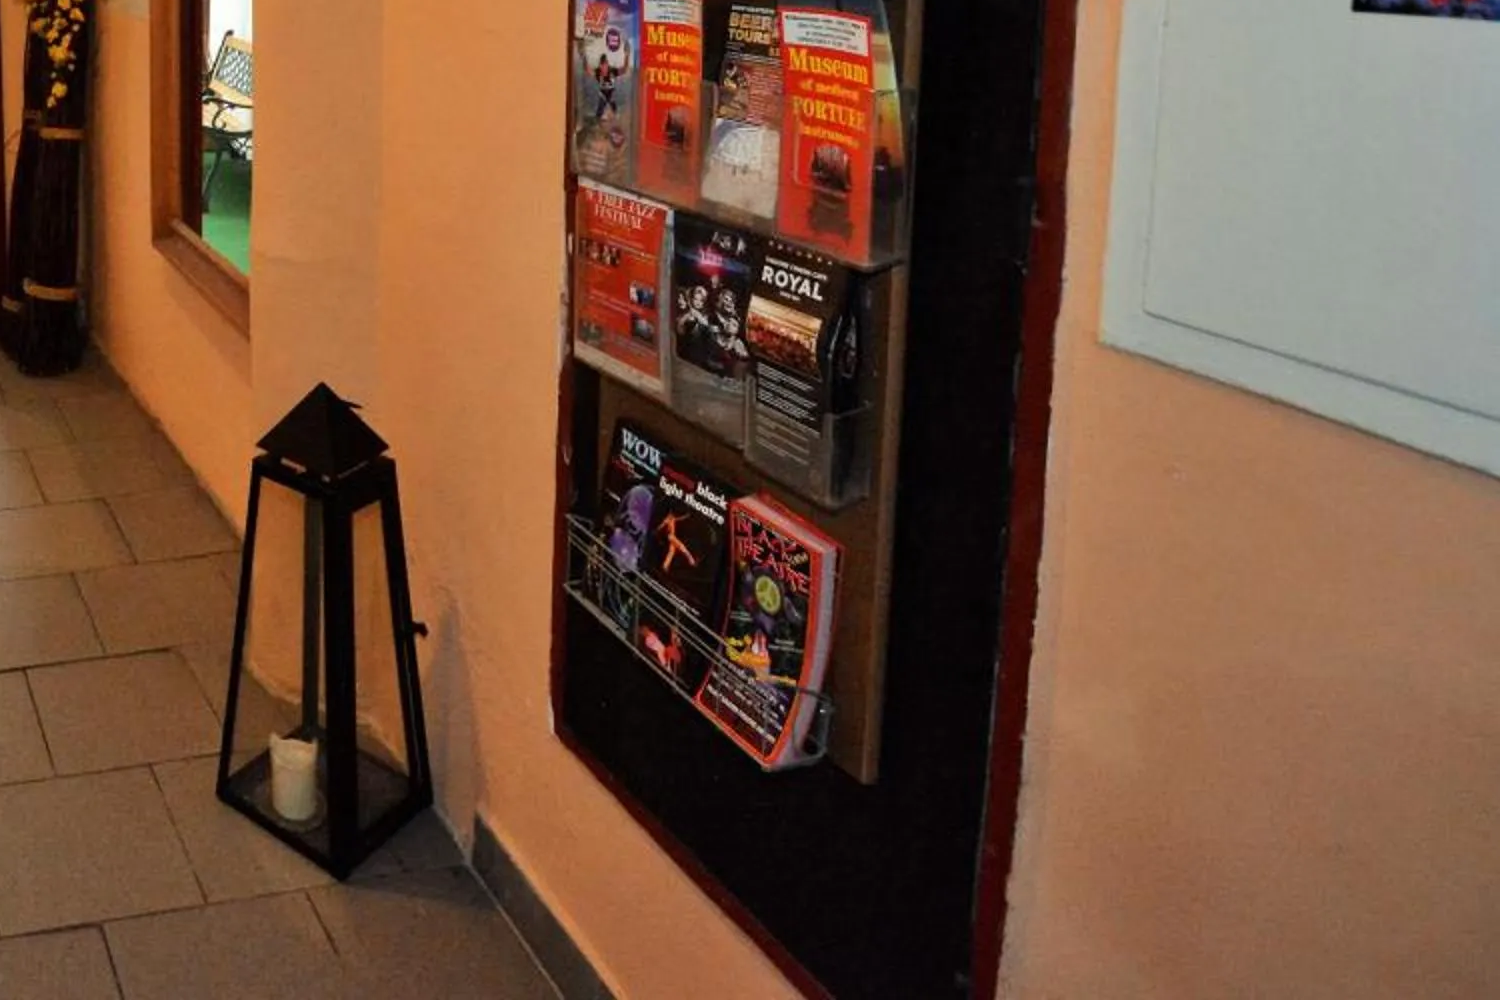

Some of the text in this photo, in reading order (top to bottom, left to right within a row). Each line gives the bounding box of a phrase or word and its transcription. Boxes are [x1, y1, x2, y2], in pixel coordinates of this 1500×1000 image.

[788, 47, 868, 84] Museum
[761, 265, 823, 301] ROYAL
[622, 427, 661, 470] WOW
[696, 481, 728, 510] black
